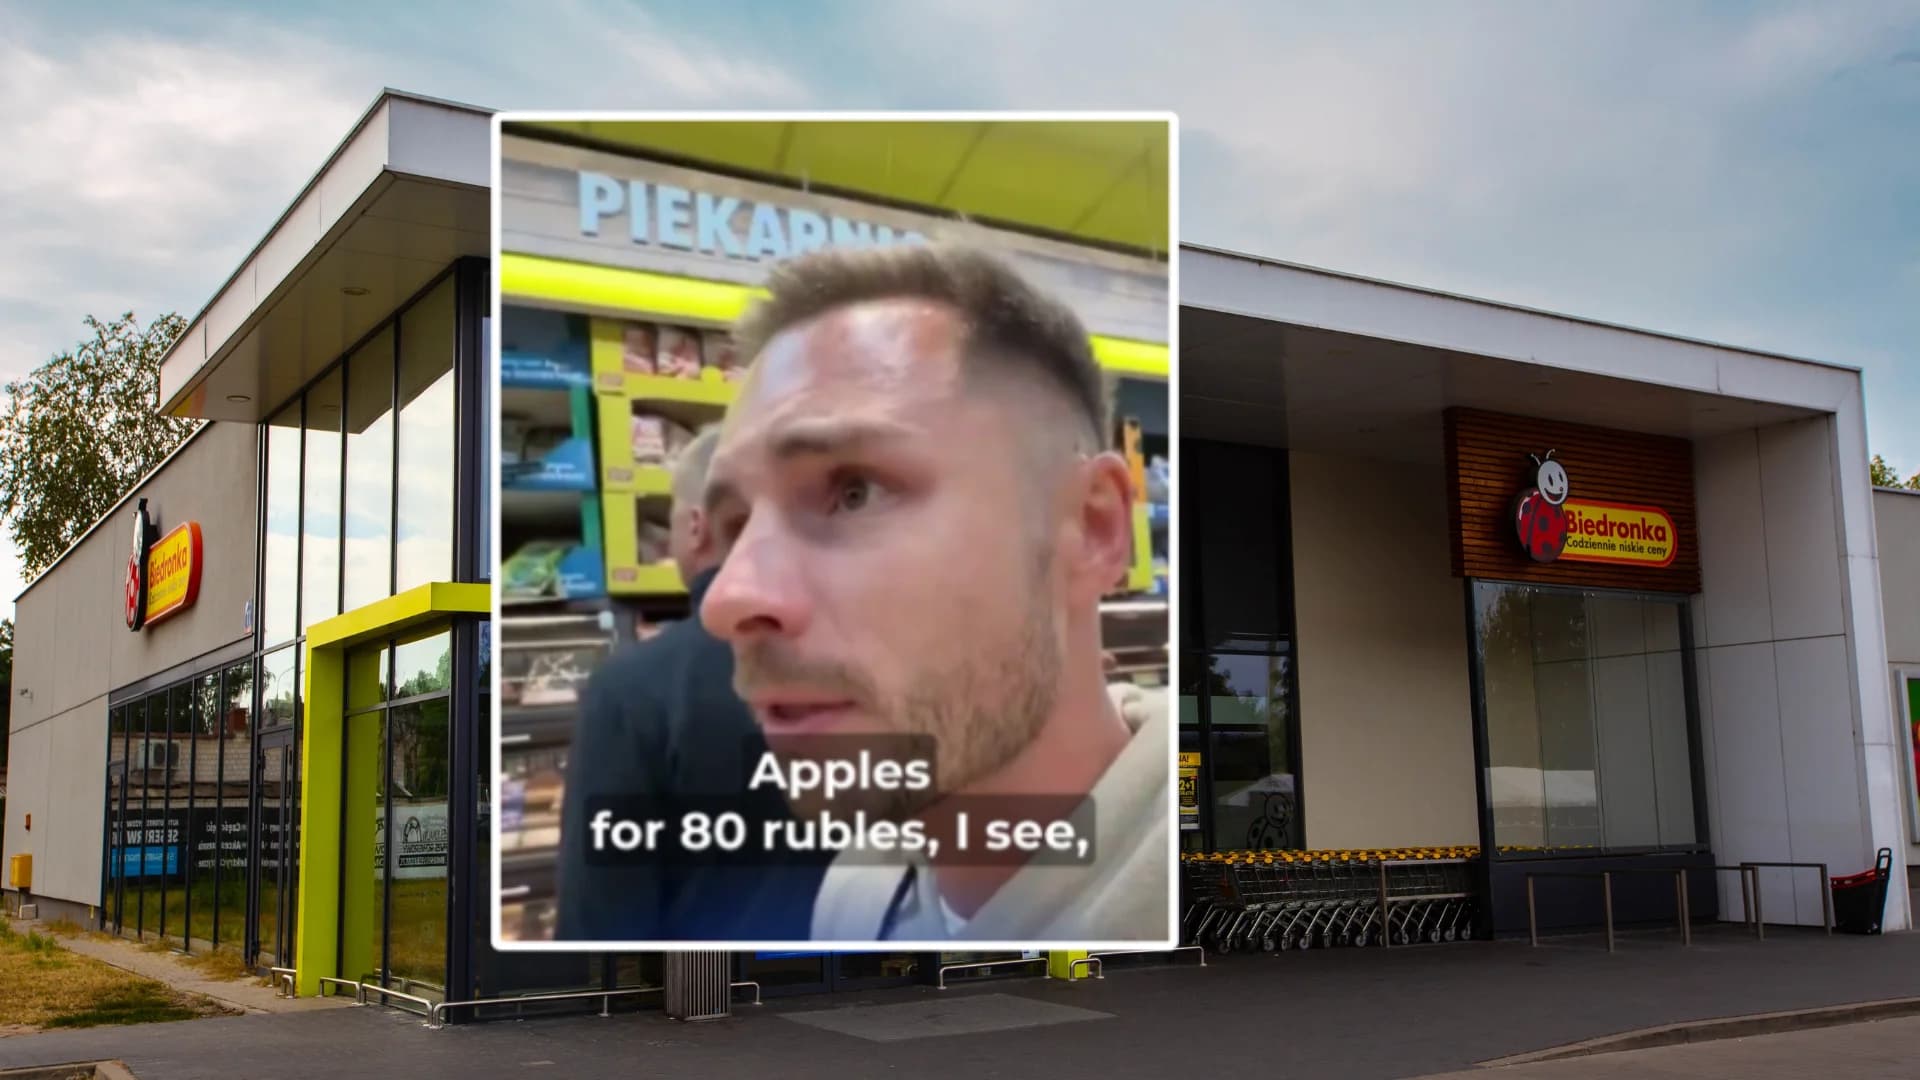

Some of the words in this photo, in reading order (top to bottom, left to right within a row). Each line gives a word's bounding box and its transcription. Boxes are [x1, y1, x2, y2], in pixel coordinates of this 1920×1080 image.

[1565, 510, 1667, 542] Biedronka
[1566, 536, 1616, 552] Codziennie
[1619, 540, 1645, 554] niskie
[1647, 545, 1668, 557] ceny
[150, 543, 188, 589] Biedronka
